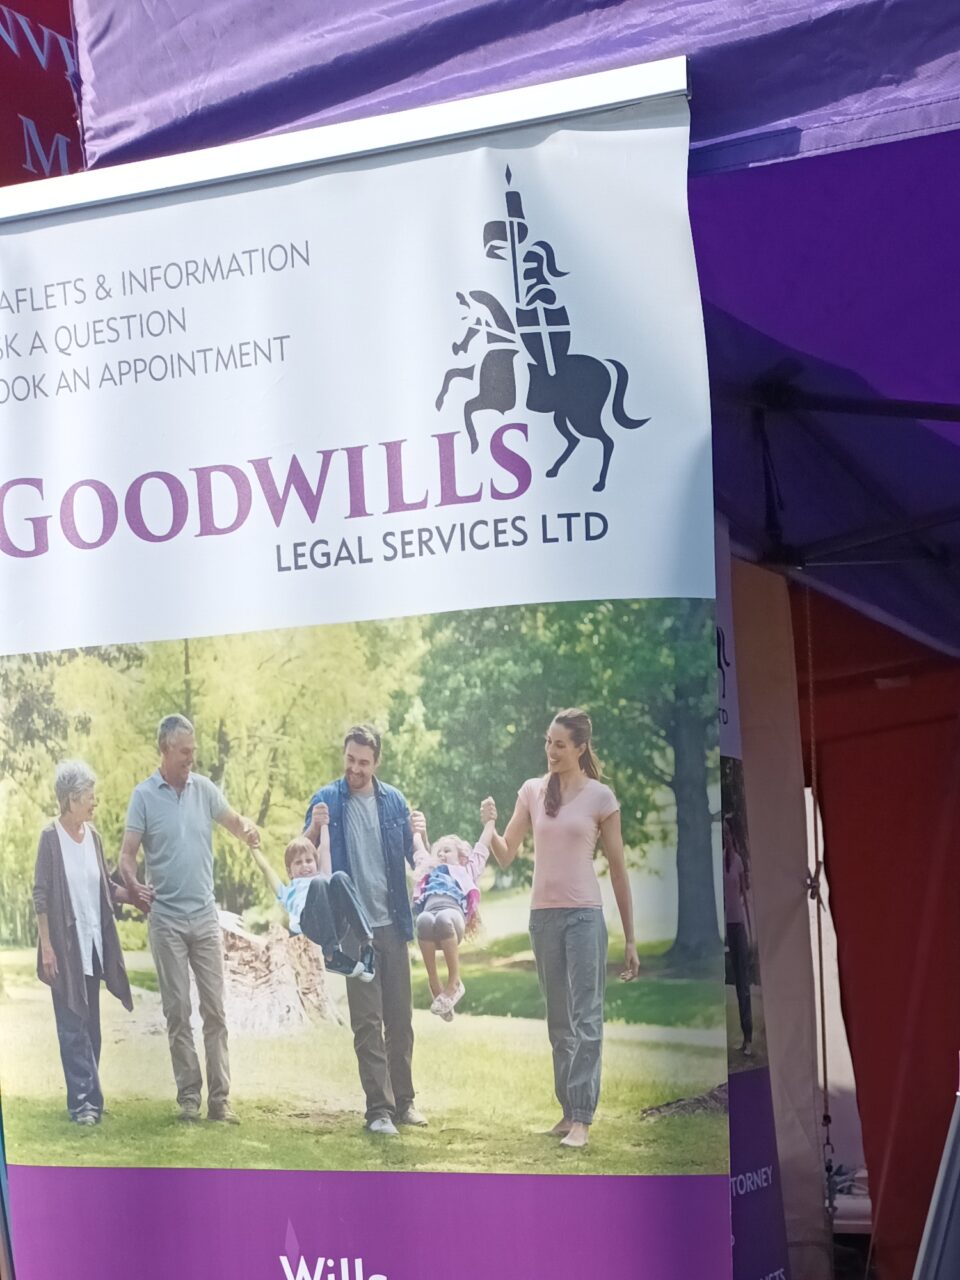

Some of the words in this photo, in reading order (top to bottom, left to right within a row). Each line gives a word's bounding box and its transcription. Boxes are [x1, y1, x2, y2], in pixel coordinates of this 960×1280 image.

[0, 278, 86, 314] AFLETS
[95, 274, 112, 300] &
[122, 240, 310, 296] INFORMATION
[29, 331, 48, 356] A
[55, 307, 187, 356] QUESTION
[0, 373, 49, 404] OOK
[56, 366, 90, 396] AN
[99, 335, 291, 388] APPOINTMENT
[0, 423, 532, 558] GOODWILLS
[275, 534, 374, 572] LEGAL
[382, 515, 529, 560] SERVICES
[540, 511, 609, 544] LTD
[731, 1165, 773, 1196] TORNEY
